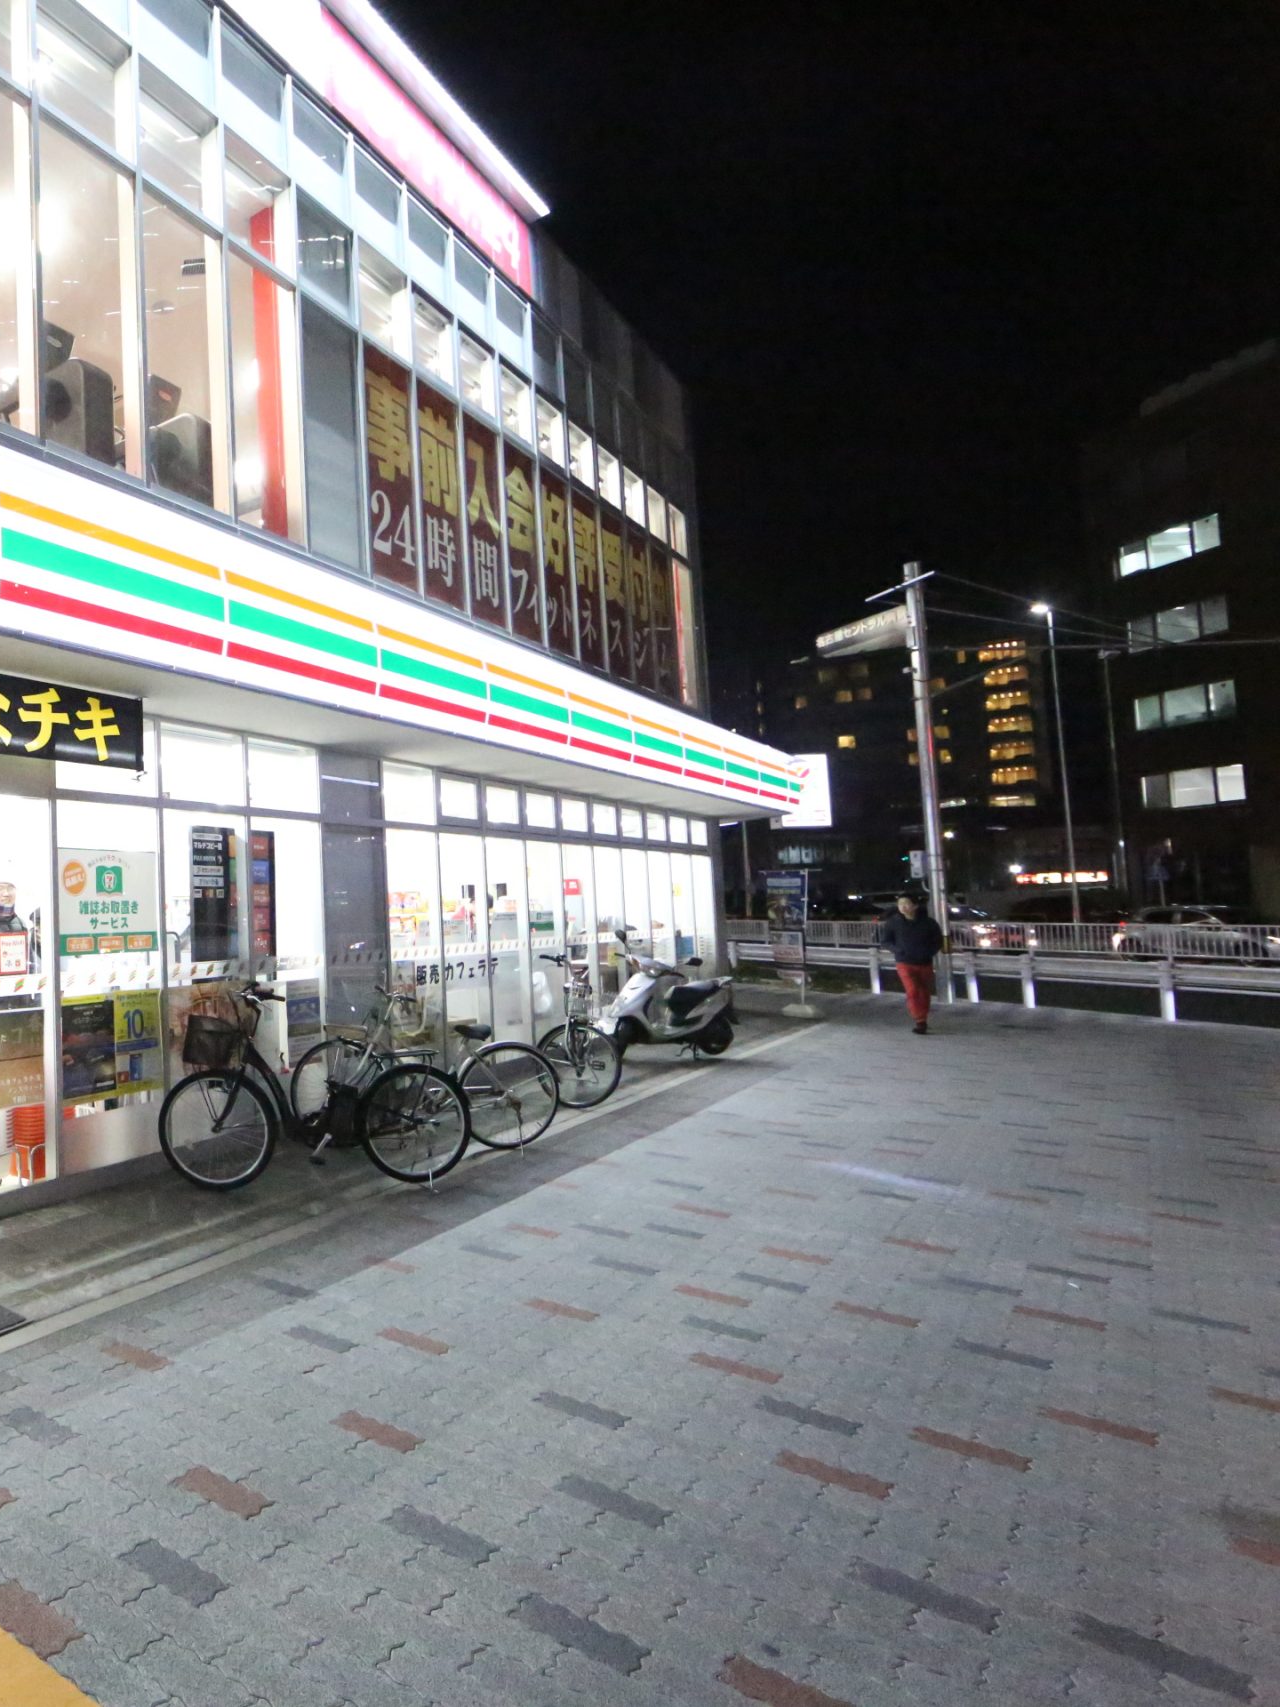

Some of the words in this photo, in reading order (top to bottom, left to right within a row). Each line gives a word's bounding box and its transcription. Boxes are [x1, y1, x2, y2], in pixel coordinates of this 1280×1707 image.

[79, 900, 139, 915] 雑誌お取置き
[89, 917, 129, 929] サービス
[123, 1008, 145, 1039] 10
